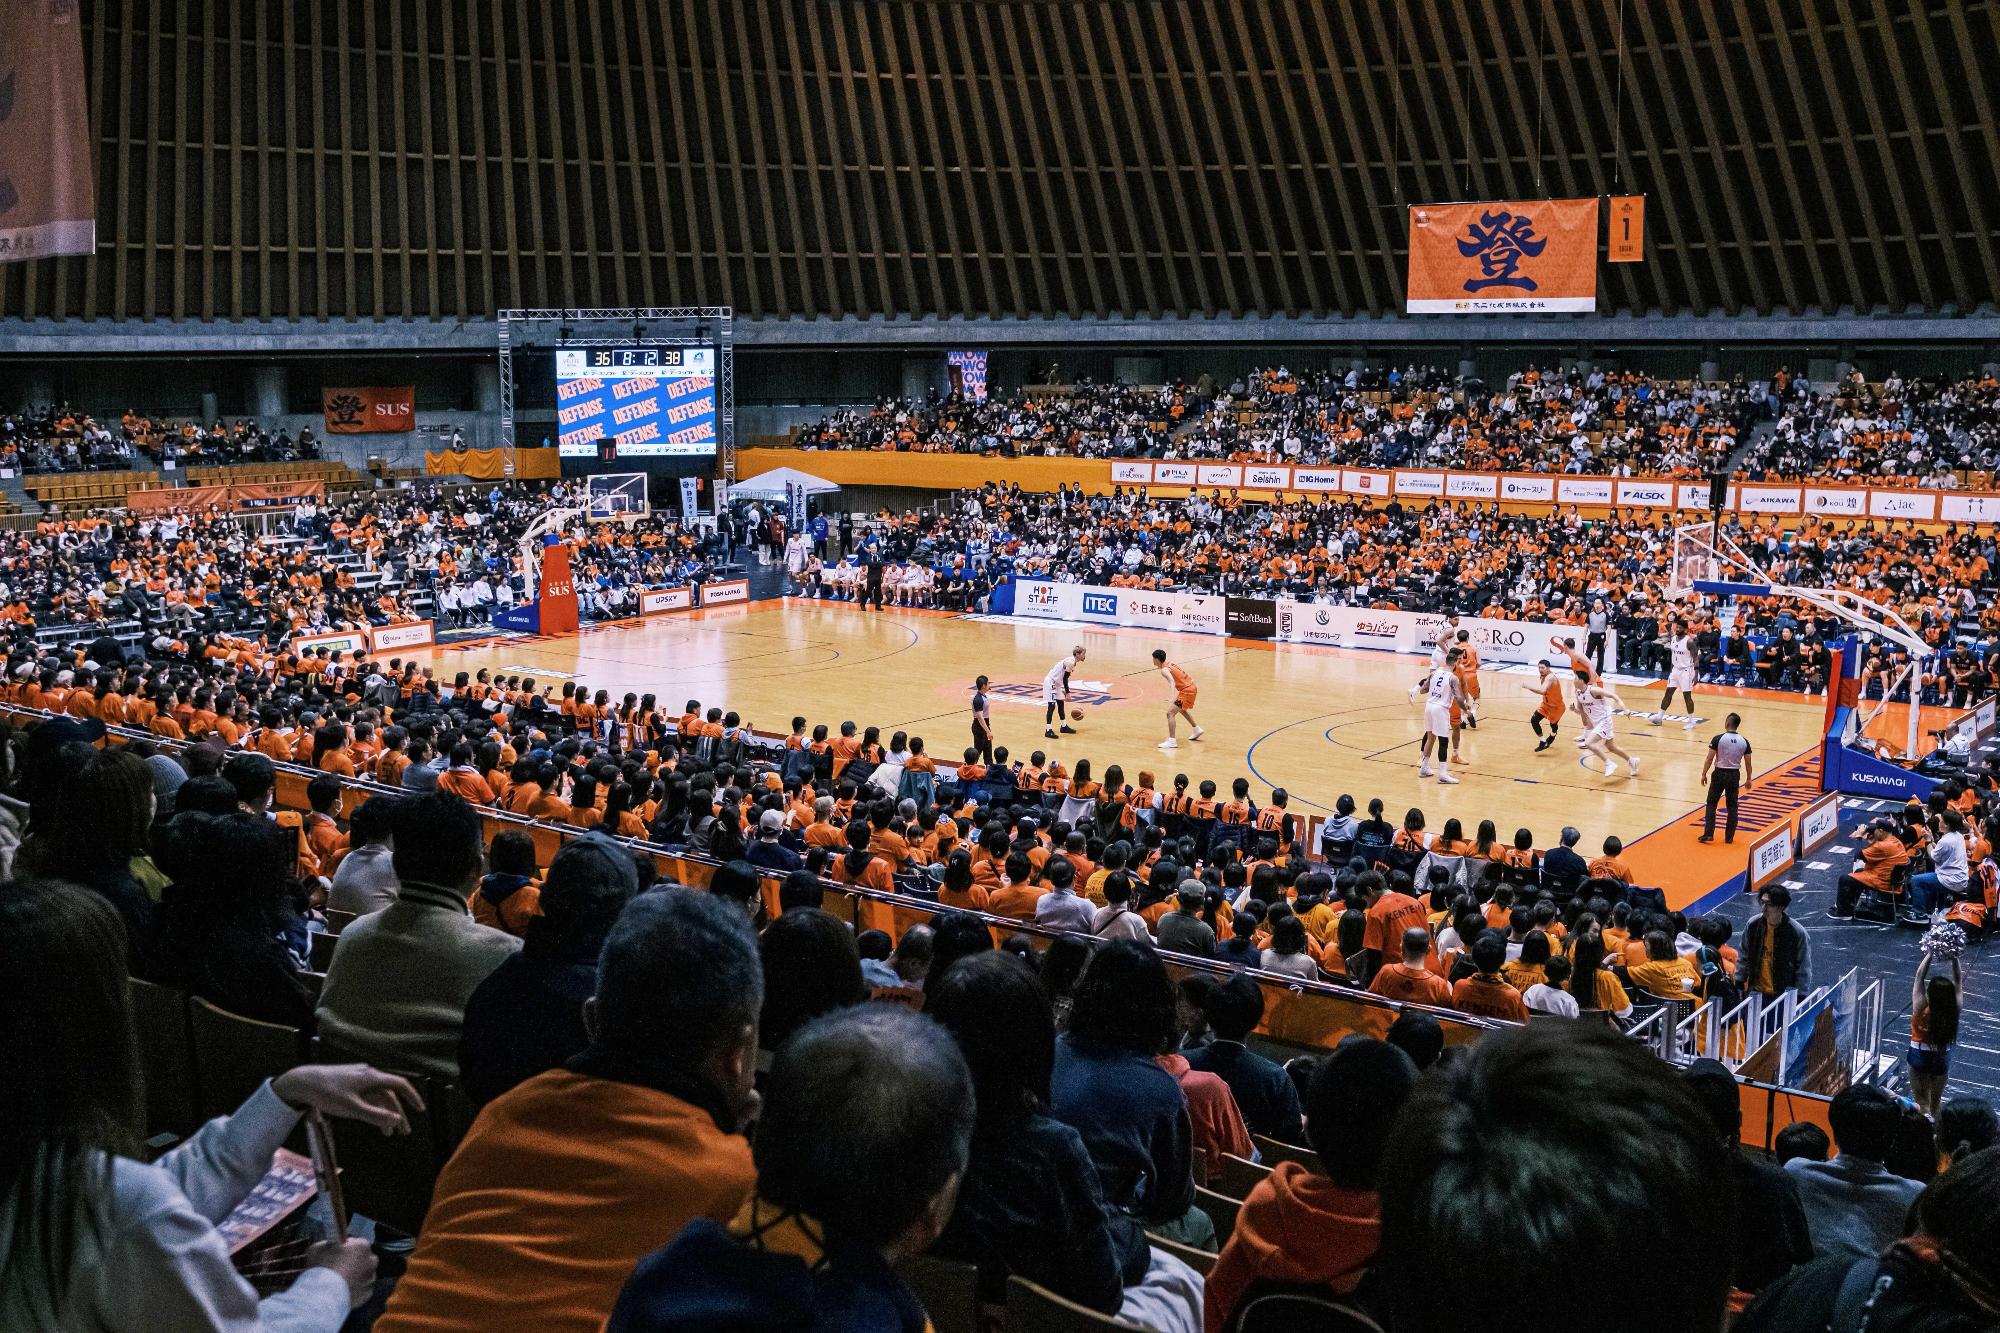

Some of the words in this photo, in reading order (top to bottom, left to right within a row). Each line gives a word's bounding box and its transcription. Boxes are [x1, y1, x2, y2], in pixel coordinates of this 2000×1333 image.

[1622, 218, 1630, 240] 1
[1456, 210, 1547, 293] 登
[595, 352, 610, 366] 36
[665, 352, 680, 365] 38
[557, 378, 605, 400] DEFENSE
[612, 377, 660, 400] DEFENSE
[667, 377, 714, 400] DEFENSE
[376, 403, 410, 416] SUS
[558, 398, 606, 426] DEFENSE
[613, 397, 660, 425] DEFENSE
[668, 396, 715, 424] DEFENSE
[559, 423, 606, 445] DEFENSE
[615, 422, 661, 444] DEFENSE
[668, 422, 716, 444] DEFENSE
[1252, 474, 1280, 484] Seishin
[1632, 492, 1665, 500] ALSOK
[549, 586, 570, 597] SUS
[1086, 596, 1115, 612] ITEC
[1142, 604, 1173, 616] 日本生命
[1181, 613, 1220, 623] INFRONEER
[1240, 613, 1273, 624] SoftBank
[1303, 631, 1341, 640] りそなグループ
[1356, 621, 1399, 634] ゆうパック
[1493, 630, 1524, 646] R&O
[1436, 677, 1444, 687] 2
[1852, 772, 1906, 787] KUSANAGI
[1262, 812, 1274, 829] 10
